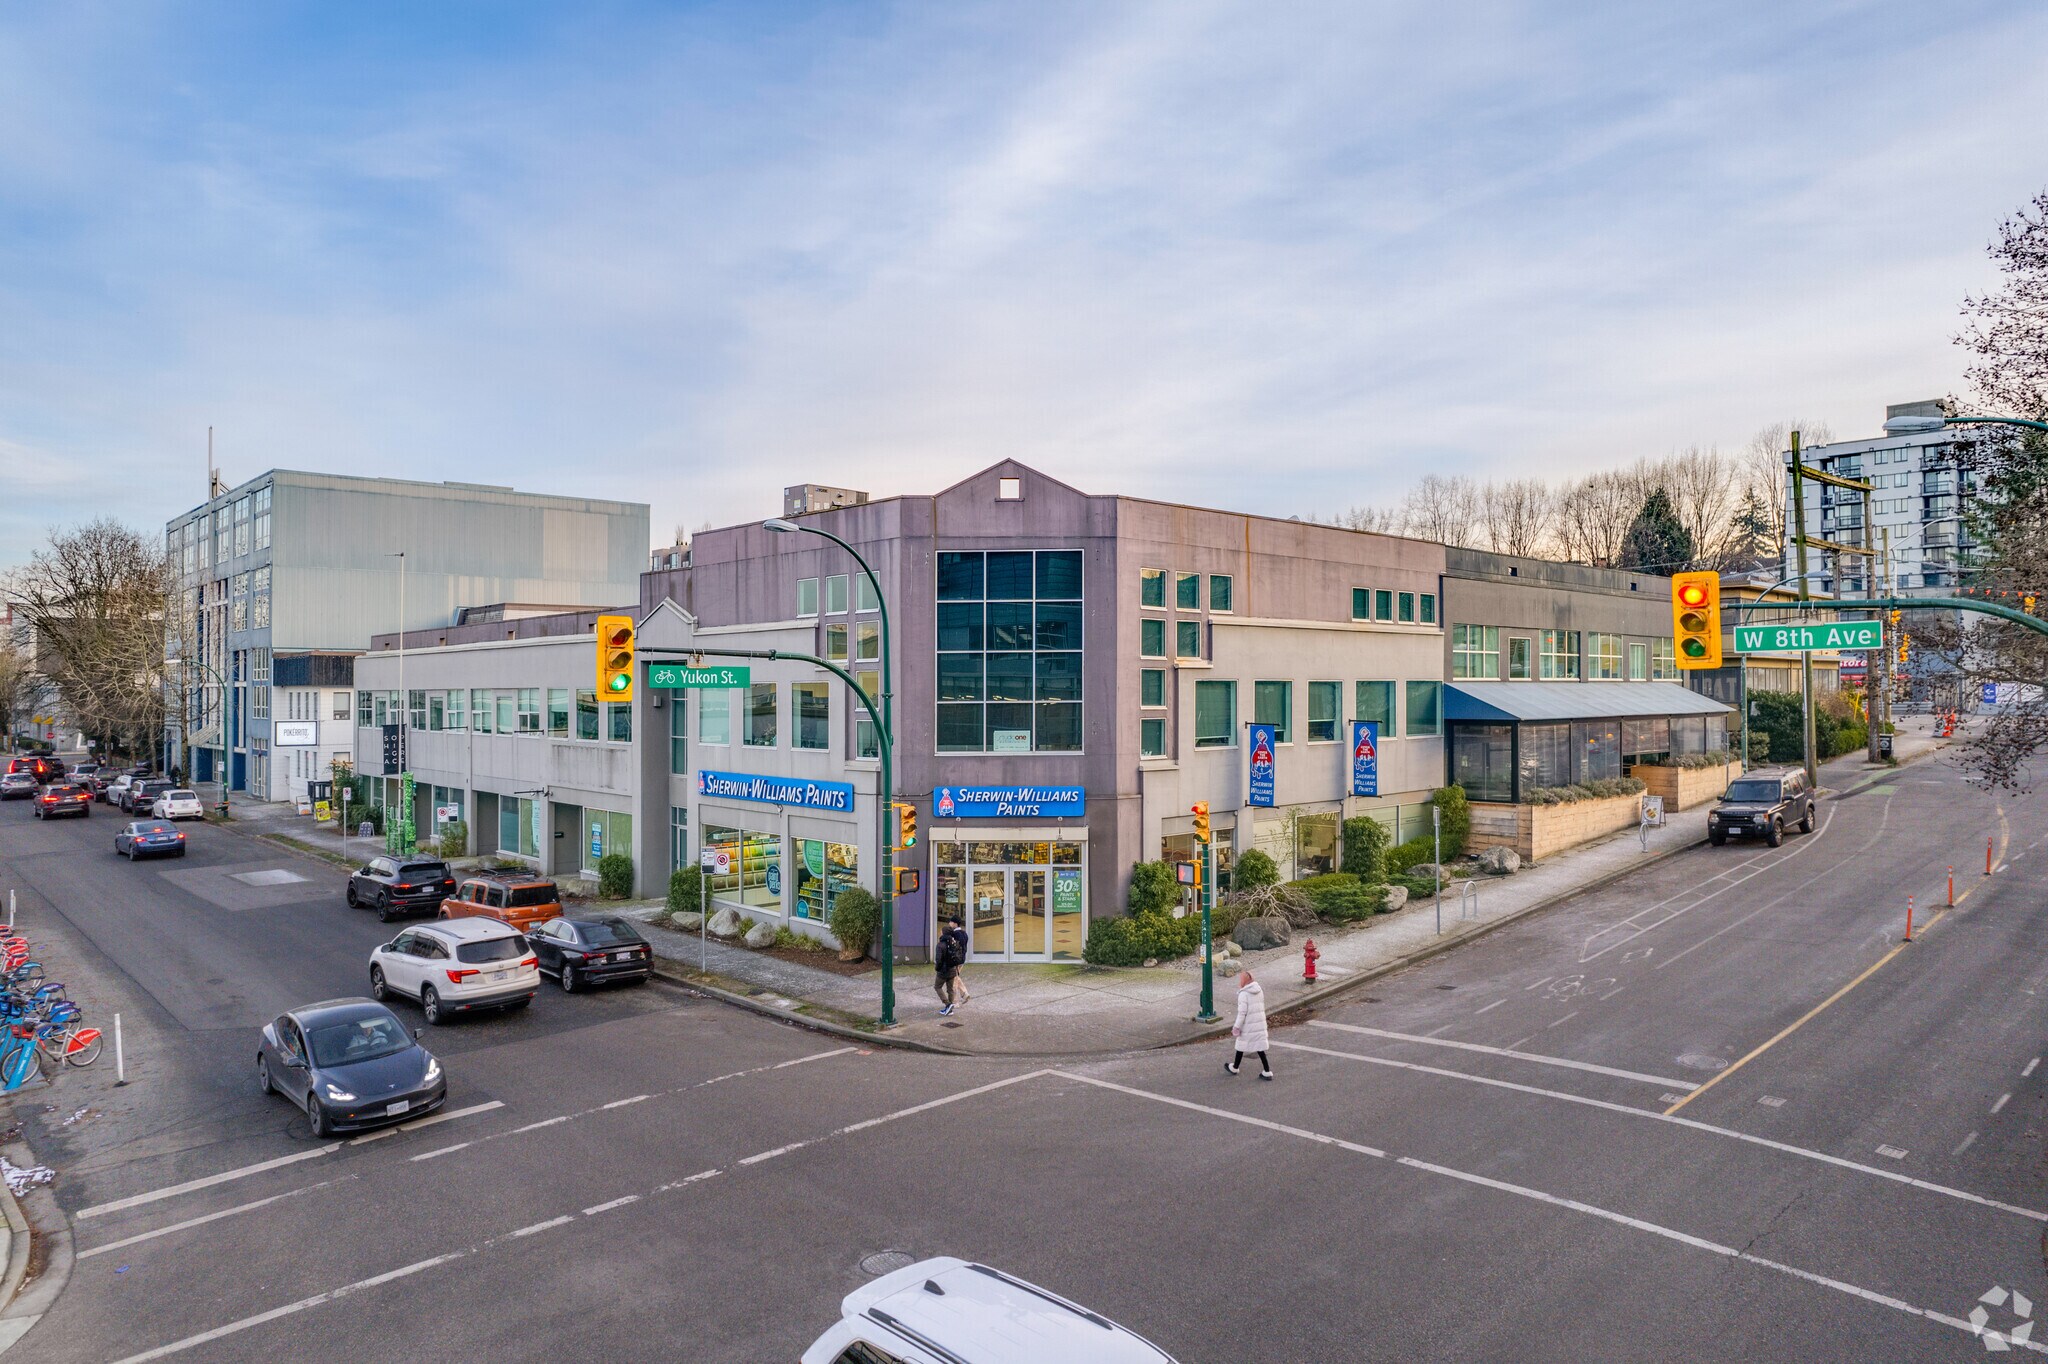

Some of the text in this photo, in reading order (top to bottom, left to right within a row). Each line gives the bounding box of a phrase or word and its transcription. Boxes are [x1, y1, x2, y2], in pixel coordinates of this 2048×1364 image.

[1744, 628, 1872, 648] W 8th Ave
[680, 669, 738, 684] Yukon St.
[706, 774, 845, 808] SHERWIN-WILLIAMS PAINTS
[1250, 787, 1273, 795] WILLIAMS
[1252, 780, 1273, 788] SHERWIN
[957, 788, 1079, 802] SHERWIN-WILLIAMS
[1254, 794, 1270, 803] PAINTS
[996, 802, 1040, 816] PAINTS
